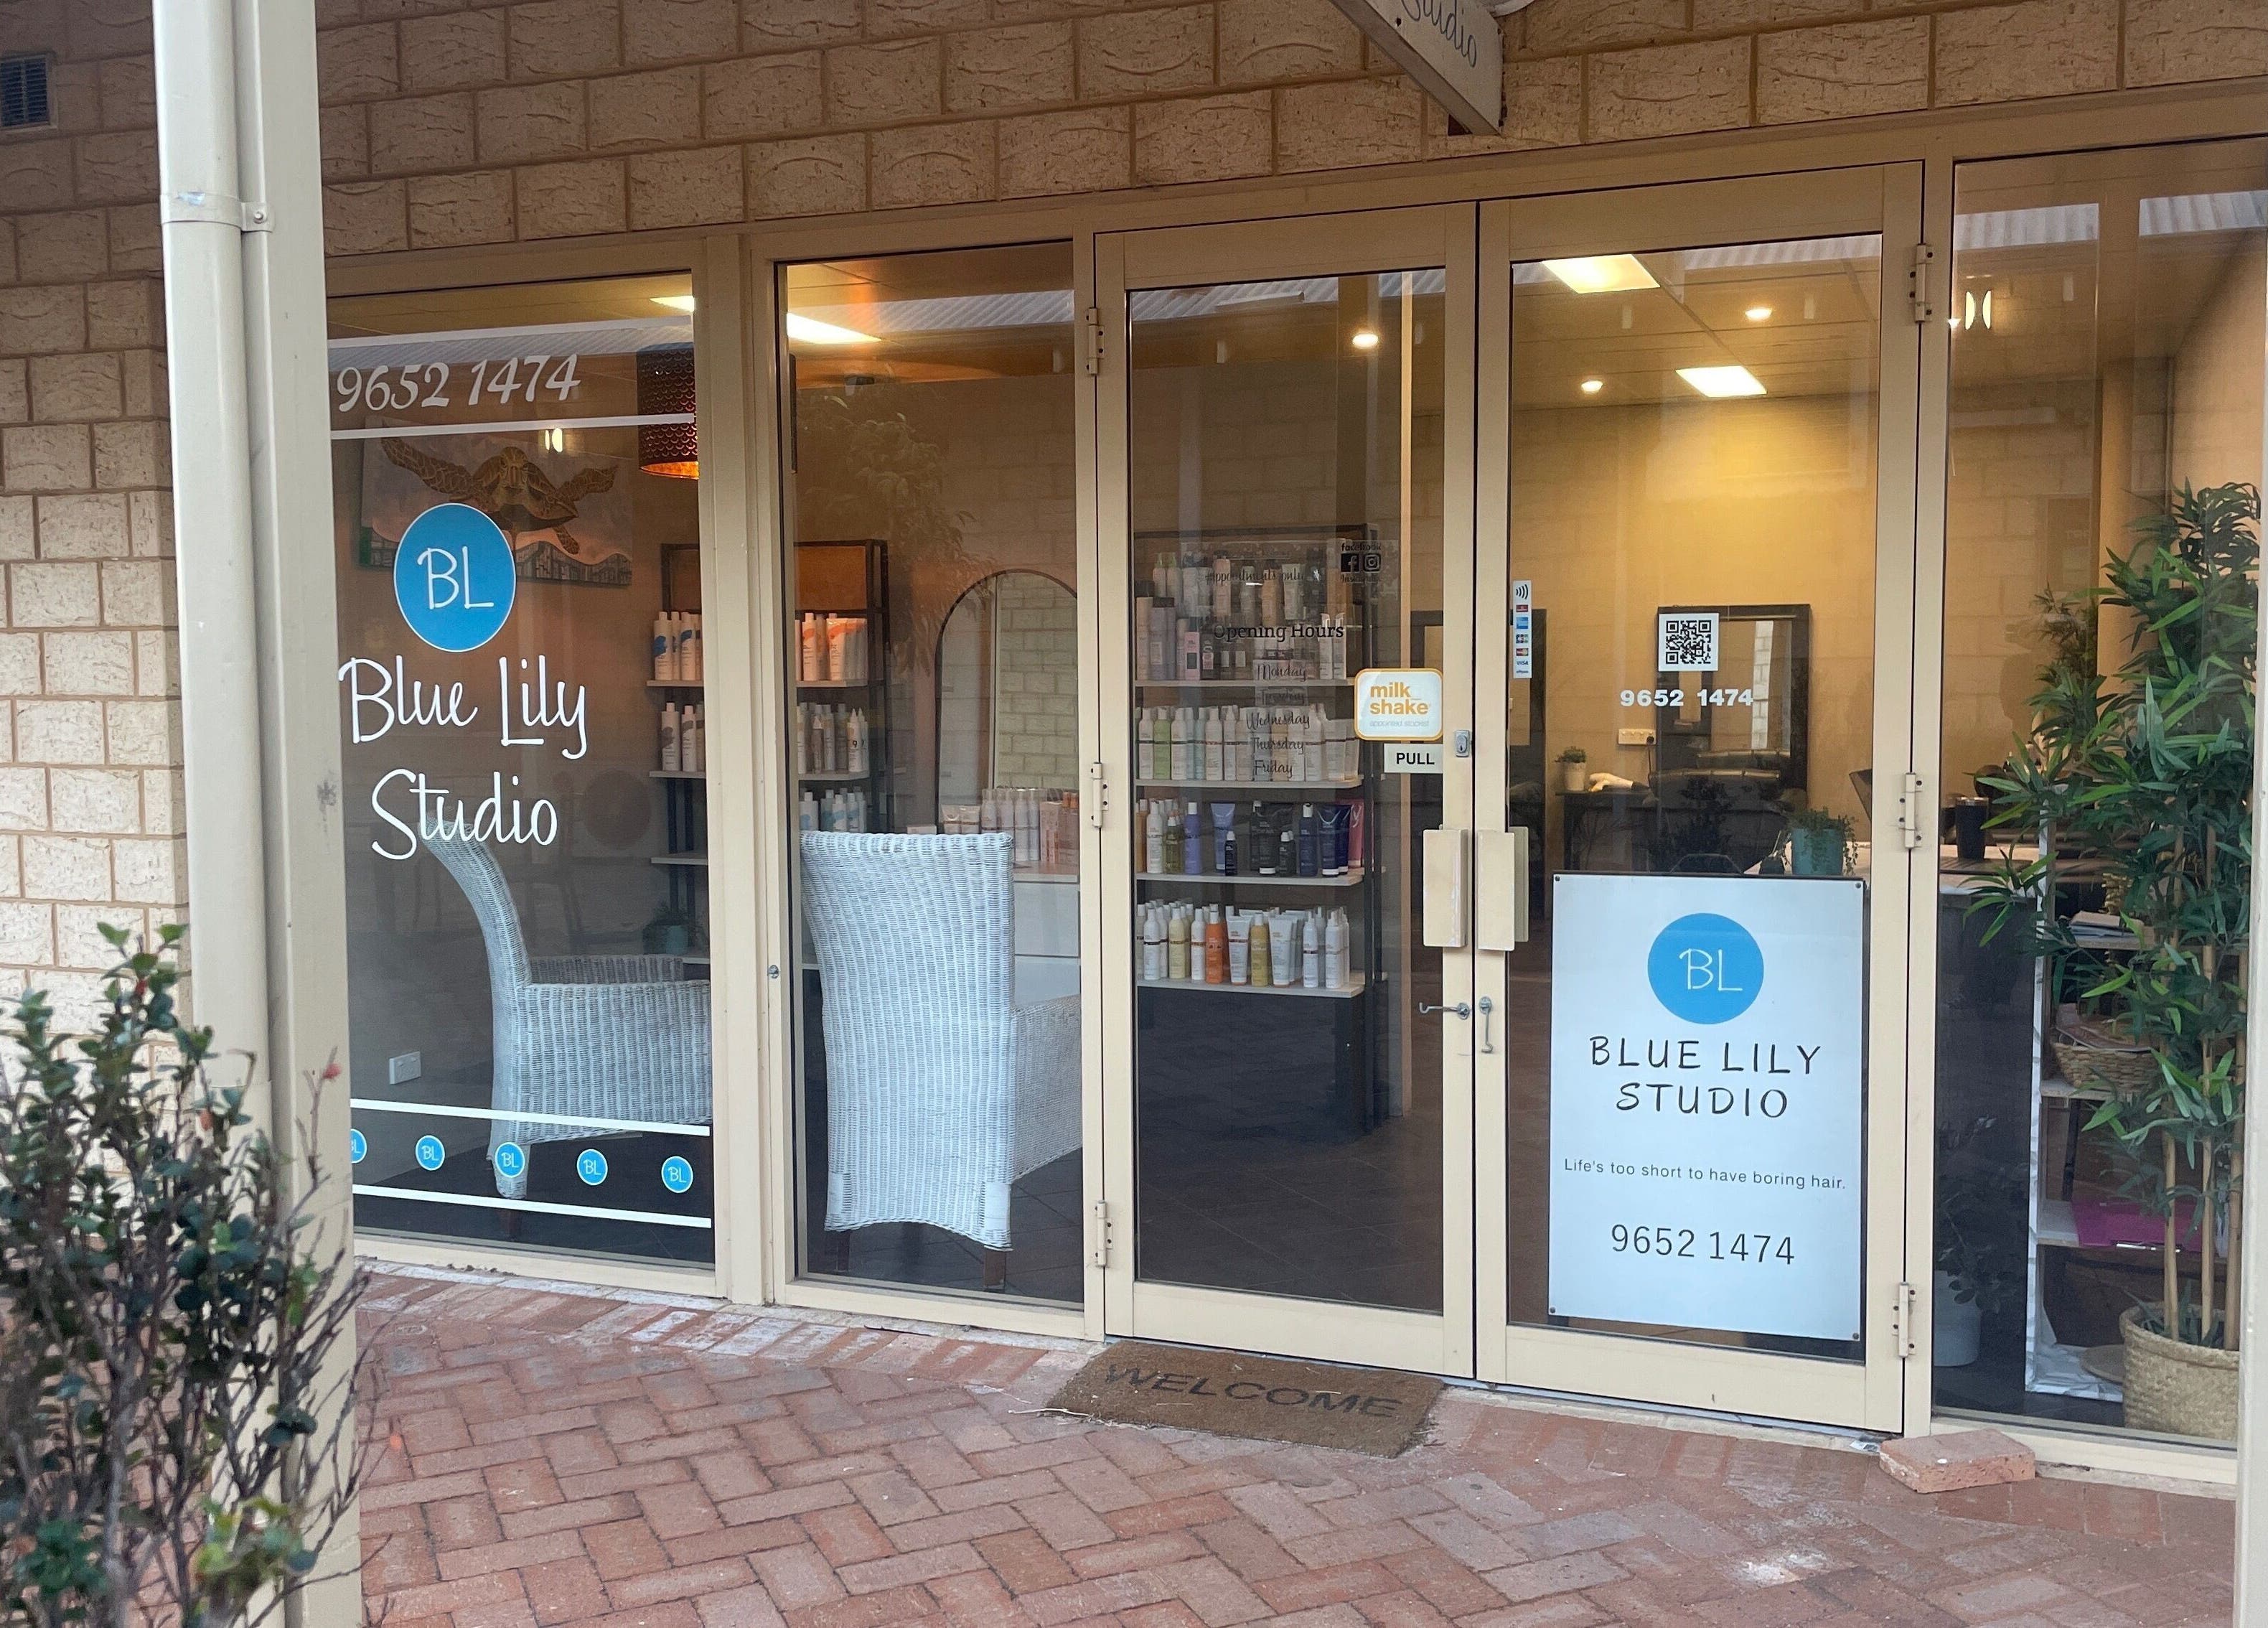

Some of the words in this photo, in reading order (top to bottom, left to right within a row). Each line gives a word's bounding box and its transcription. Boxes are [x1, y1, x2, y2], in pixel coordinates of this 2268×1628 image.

[336, 362, 451, 412] 9652
[468, 353, 582, 406] 1474
[417, 546, 495, 609] BL
[1214, 625, 1287, 642] Opening
[1290, 624, 1344, 639] Hours
[338, 655, 479, 744] Blue
[499, 655, 587, 759] Lily
[1370, 699, 1428, 715] shake
[1620, 689, 1684, 707] 9652
[1697, 689, 1753, 707] 1474
[1247, 711, 1311, 730] Wednesday
[1250, 736, 1305, 755] Thursday
[1254, 759, 1293, 777] Friday
[1396, 752, 1435, 765] PULL
[372, 769, 558, 860] Studio
[1679, 948, 1743, 991] BL
[1589, 1036, 1702, 1070] BLUE
[1723, 1042, 1821, 1075] LILY
[1616, 1082, 1788, 1118] STUDIO
[421, 1145, 440, 1161] BL
[501, 1152, 520, 1168] BL
[583, 1159, 601, 1176] BL
[667, 1166, 687, 1183] BL
[1565, 1159, 1604, 1173] Life's
[1611, 1162, 1635, 1175] too
[1641, 1164, 1682, 1179] short
[1689, 1167, 1703, 1179] to
[1709, 1169, 1747, 1183] have
[1753, 1171, 1805, 1189] boring
[1811, 1175, 1846, 1189] hair.
[1611, 1224, 1696, 1258] 9652
[1709, 1232, 1795, 1265] 1474
[1106, 1364, 1403, 1418] WELCOME
